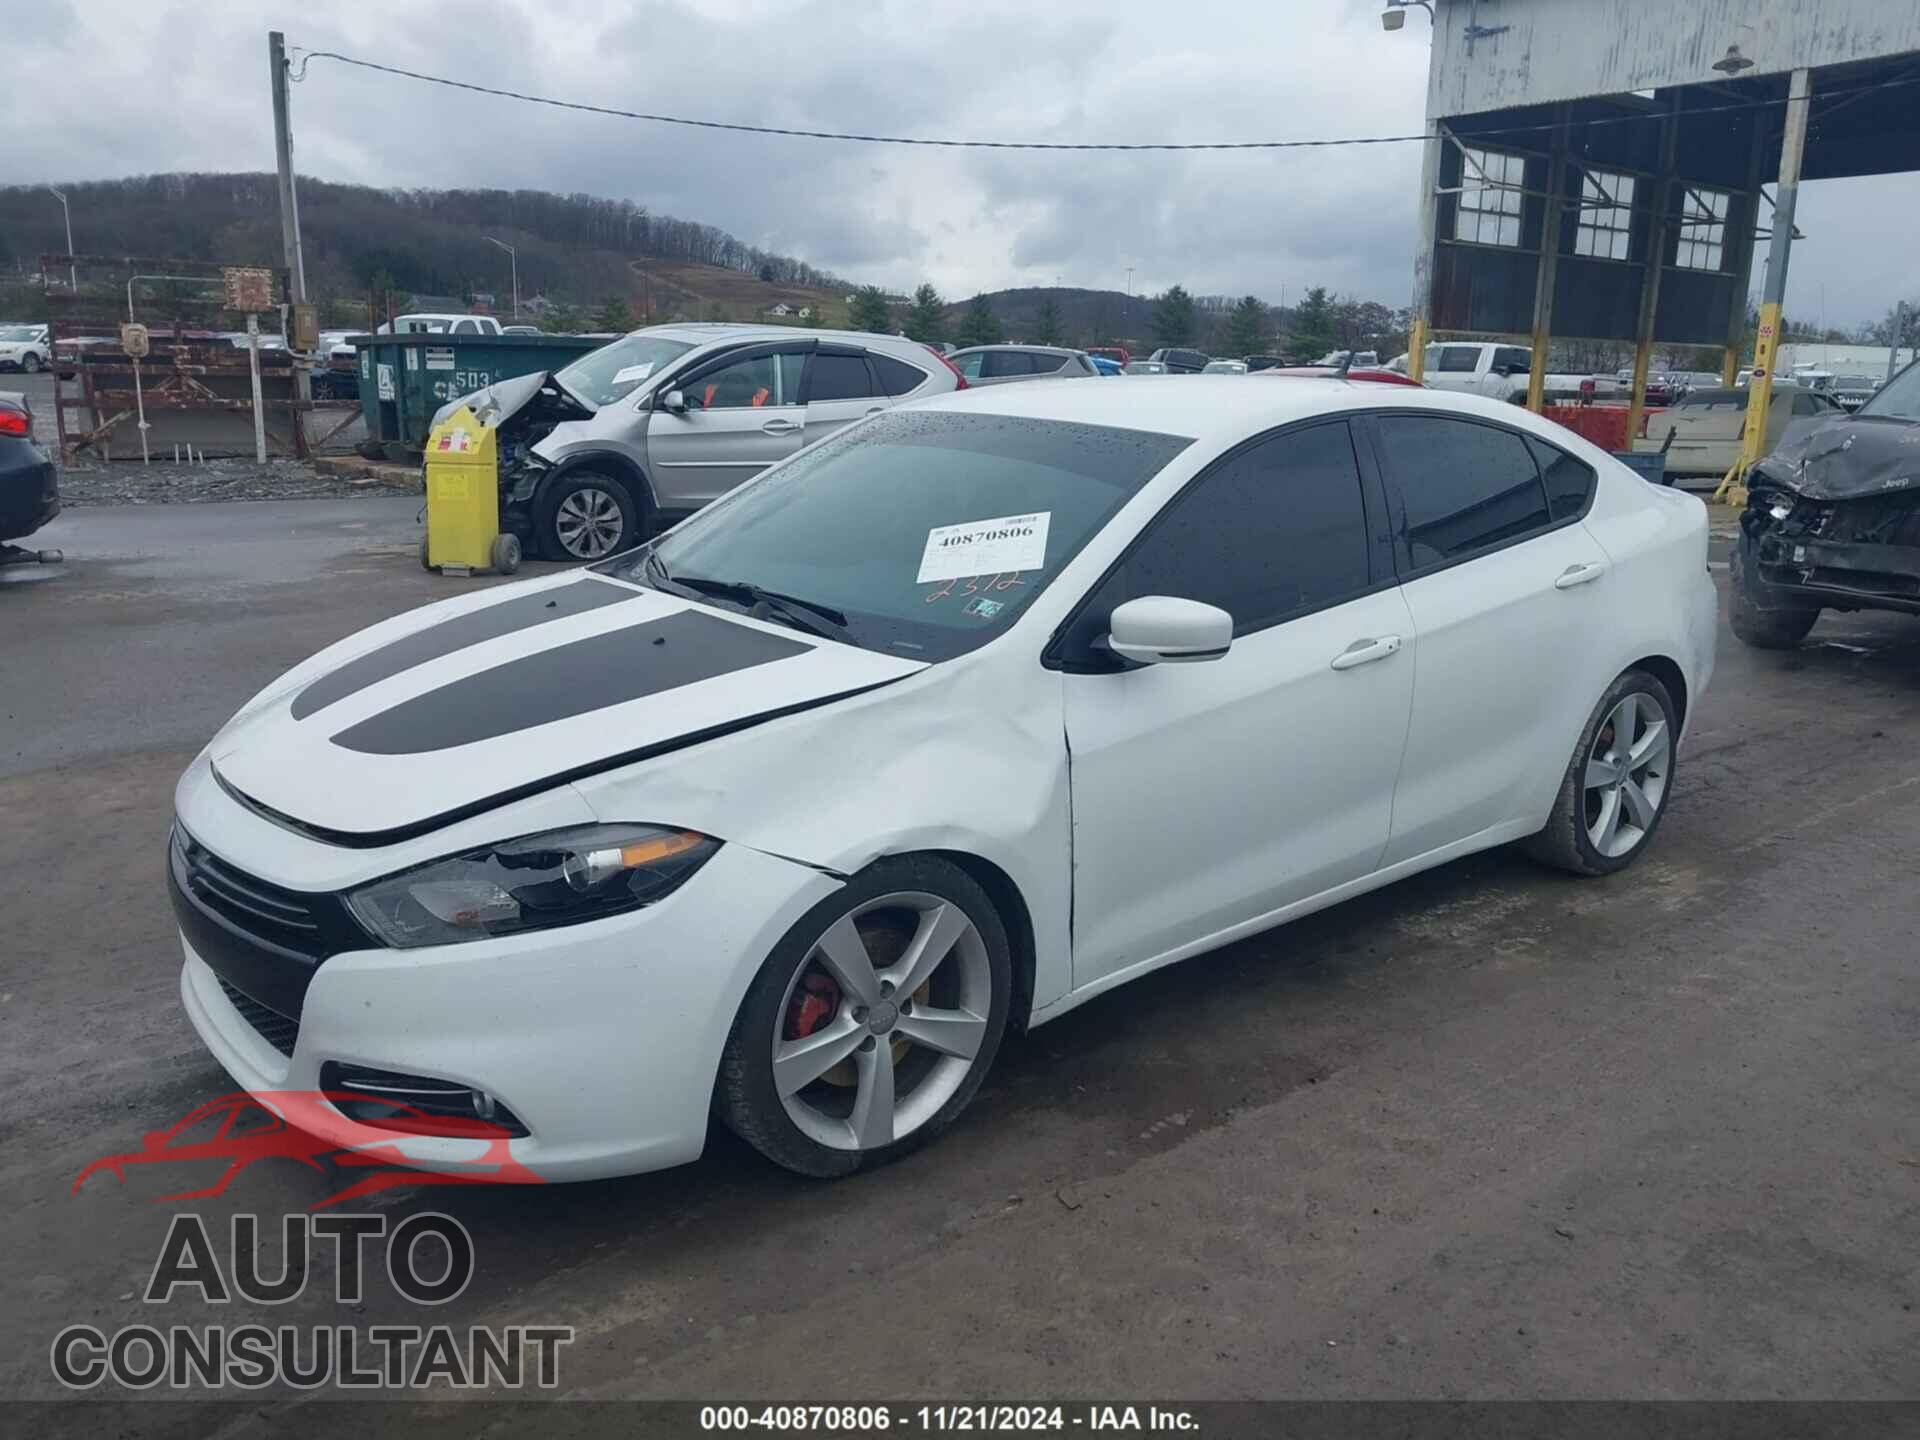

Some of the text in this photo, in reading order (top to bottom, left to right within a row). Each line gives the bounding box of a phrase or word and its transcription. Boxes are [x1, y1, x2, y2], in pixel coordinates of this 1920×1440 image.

[456, 371, 489, 388] 503
[1881, 478, 1910, 489] Jeep
[938, 526, 1034, 548] 40870806
